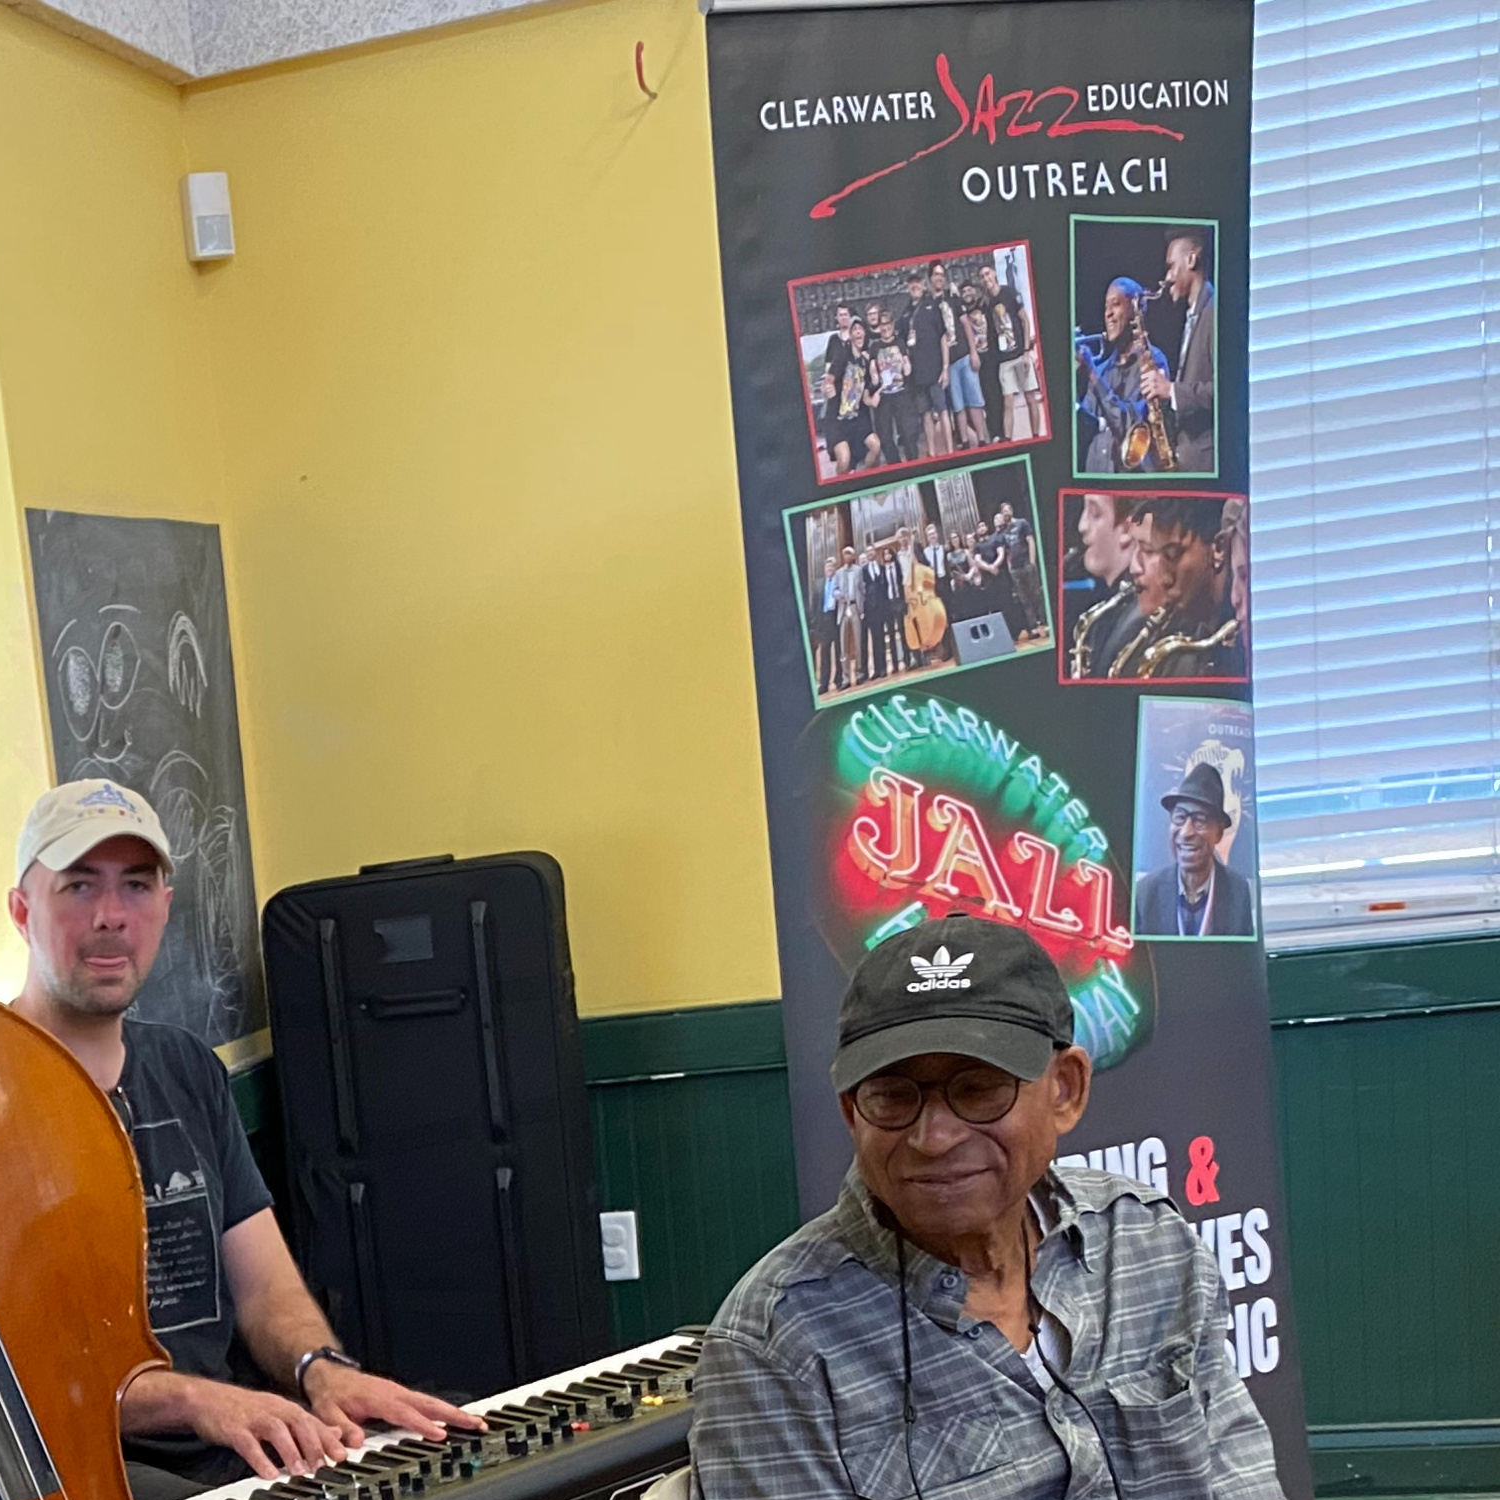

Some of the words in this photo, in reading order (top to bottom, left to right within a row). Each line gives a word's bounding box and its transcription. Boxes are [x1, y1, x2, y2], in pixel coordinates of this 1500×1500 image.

[760, 91, 936, 131] CLEARWATER
[1087, 79, 1229, 112] EDUCATION
[961, 157, 1169, 203] OUTREACH
[850, 695, 1107, 858] CLEARWATER
[851, 766, 1134, 950] JAZZ
[906, 978, 972, 993] adidas
[1185, 1136, 1220, 1206] &
